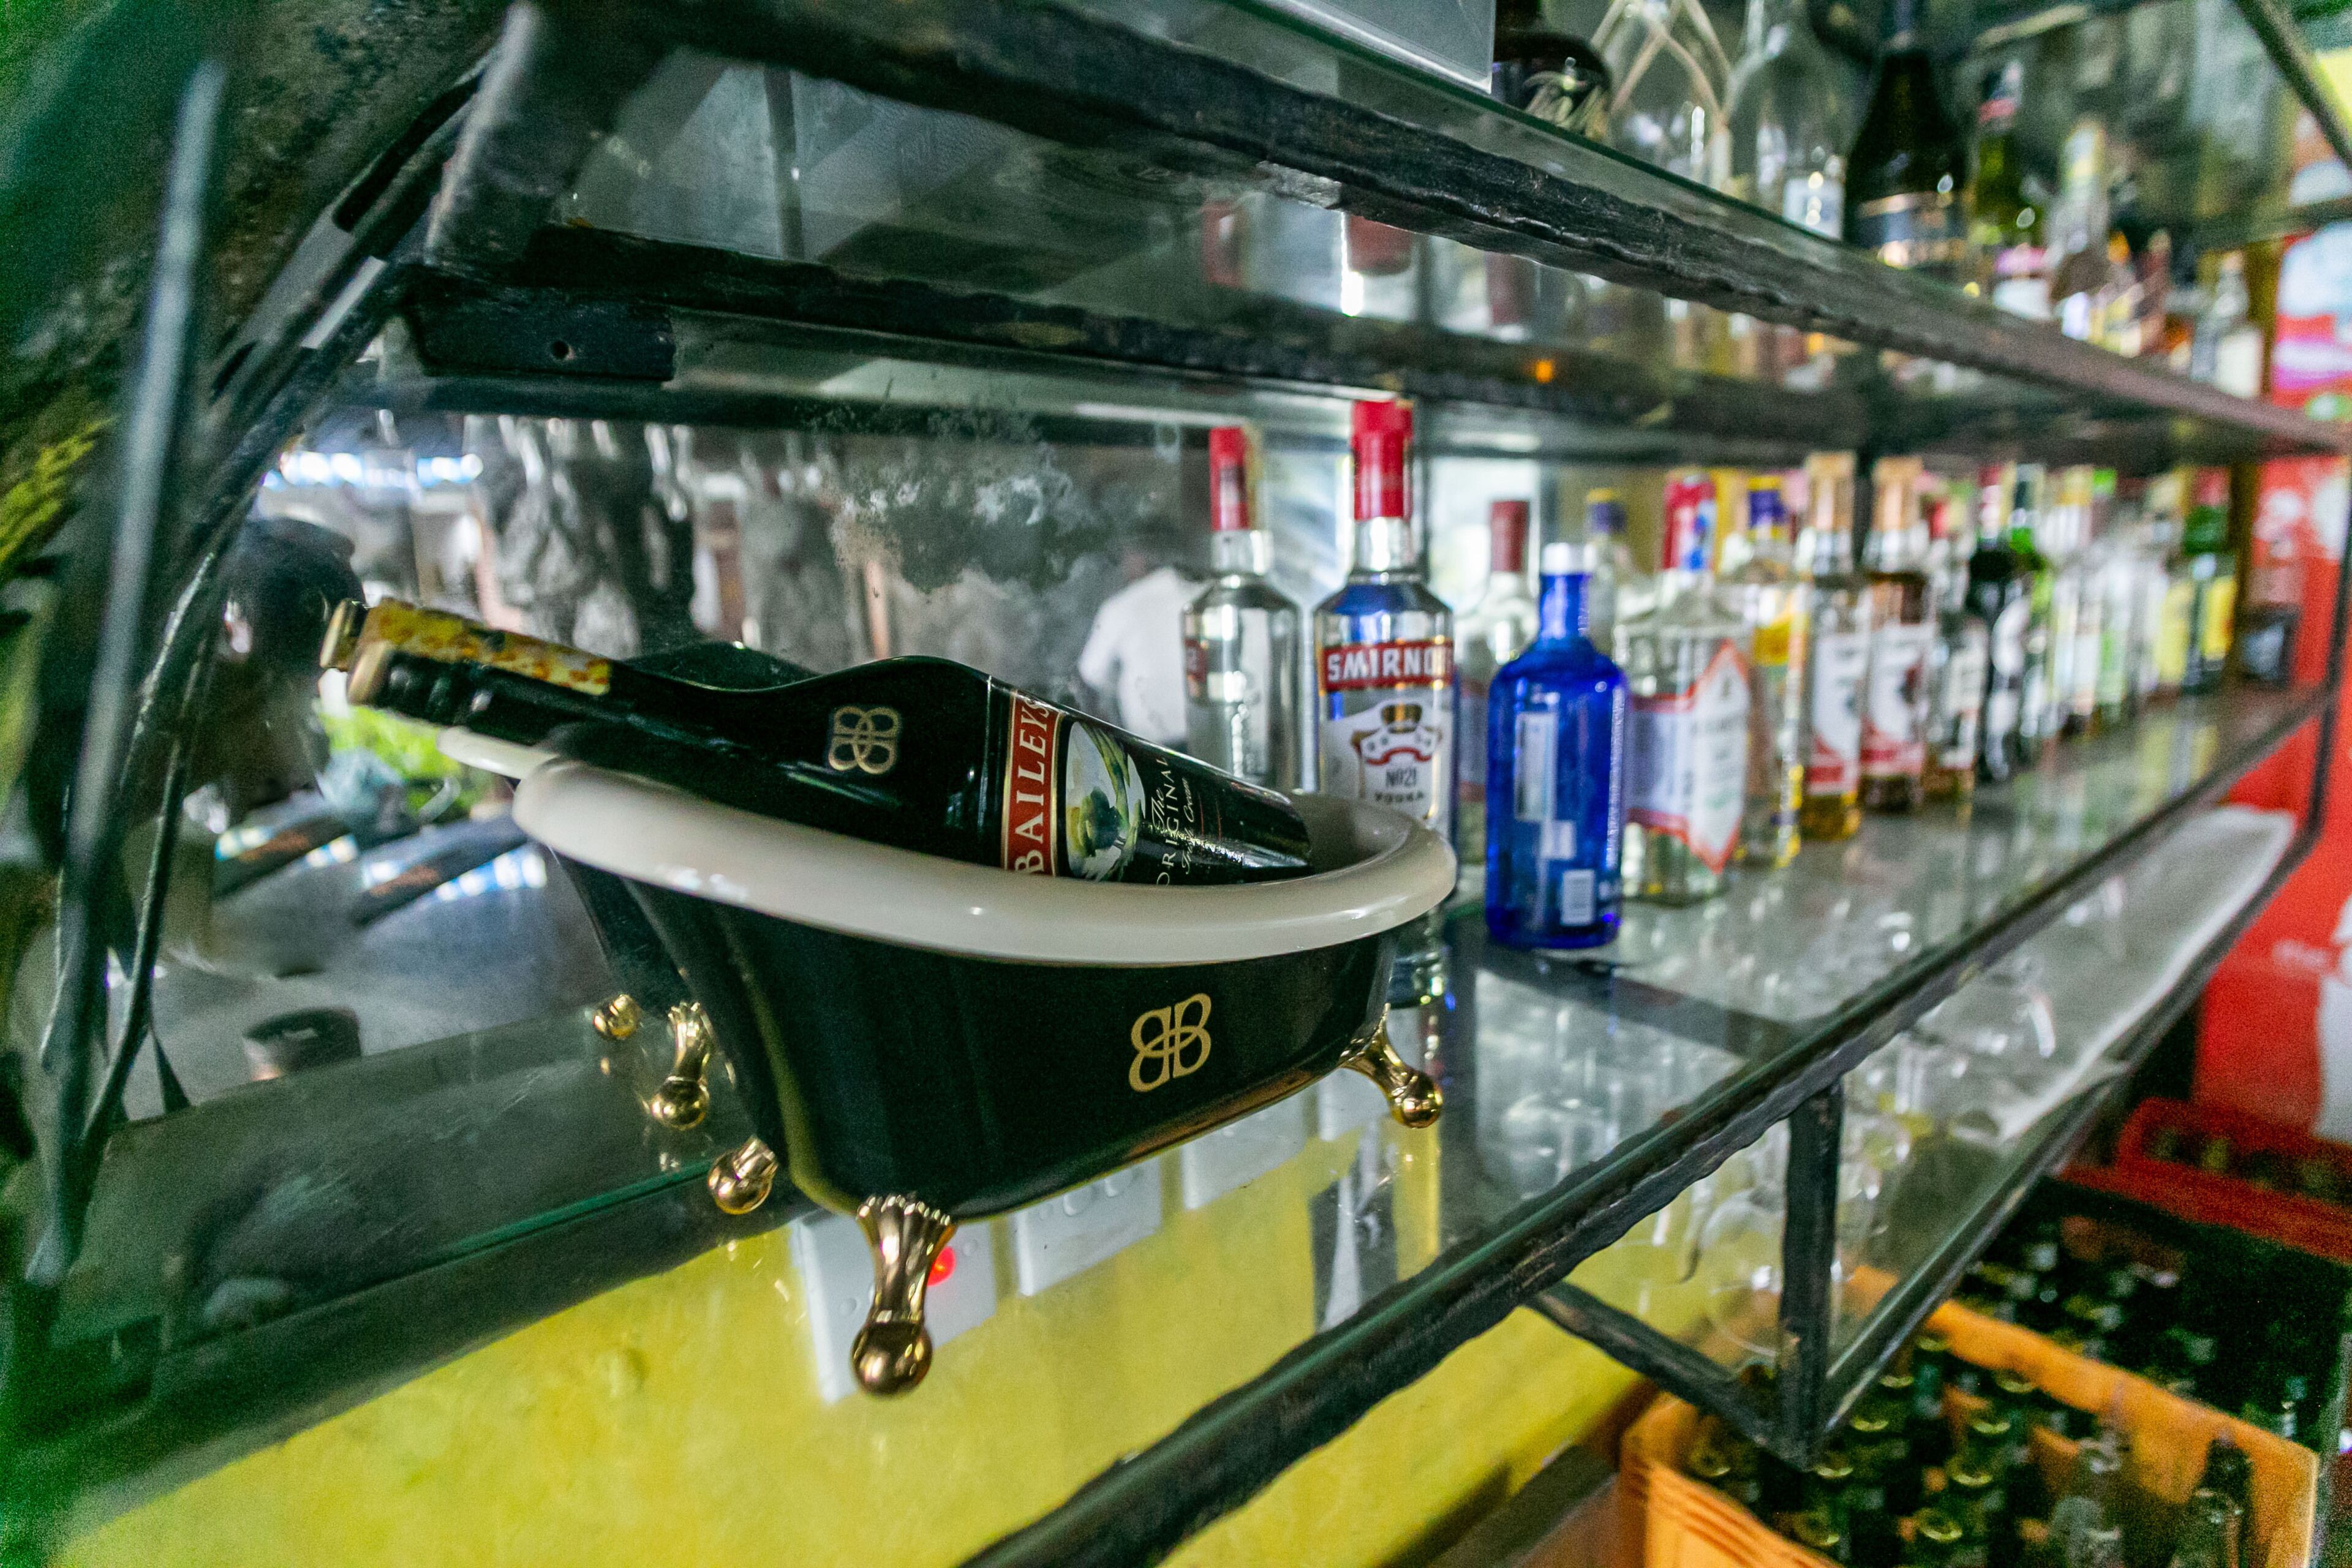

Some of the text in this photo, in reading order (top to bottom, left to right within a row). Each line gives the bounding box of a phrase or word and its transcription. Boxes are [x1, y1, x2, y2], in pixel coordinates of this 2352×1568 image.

[1327, 647, 1453, 682] SMIRNO
[1014, 696, 1049, 873] BAILEYS
[1182, 777, 1194, 823] Cream
[1152, 788, 1165, 834] The
[1156, 758, 1179, 885] ORIGINAL
